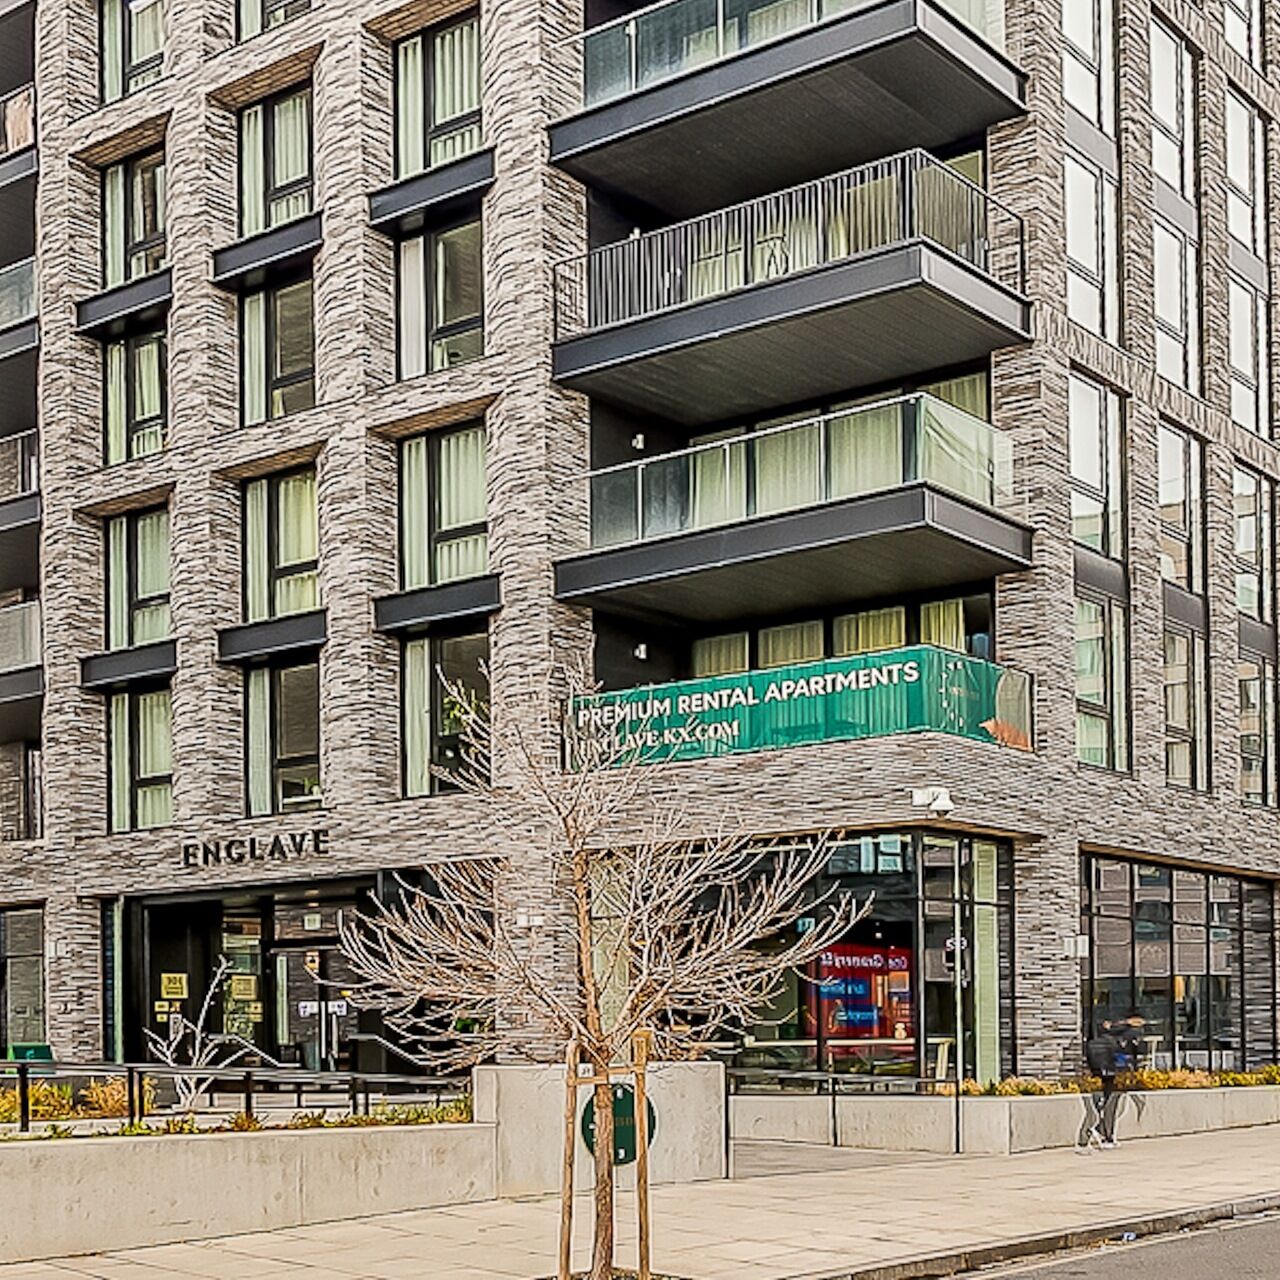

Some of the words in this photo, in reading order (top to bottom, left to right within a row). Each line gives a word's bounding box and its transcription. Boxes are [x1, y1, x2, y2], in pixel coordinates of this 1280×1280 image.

[578, 697, 671, 728] PREMIUM
[678, 686, 760, 715] RENTAL
[764, 661, 920, 703] APARTMENTS
[182, 829, 330, 867] ENCLAVE
